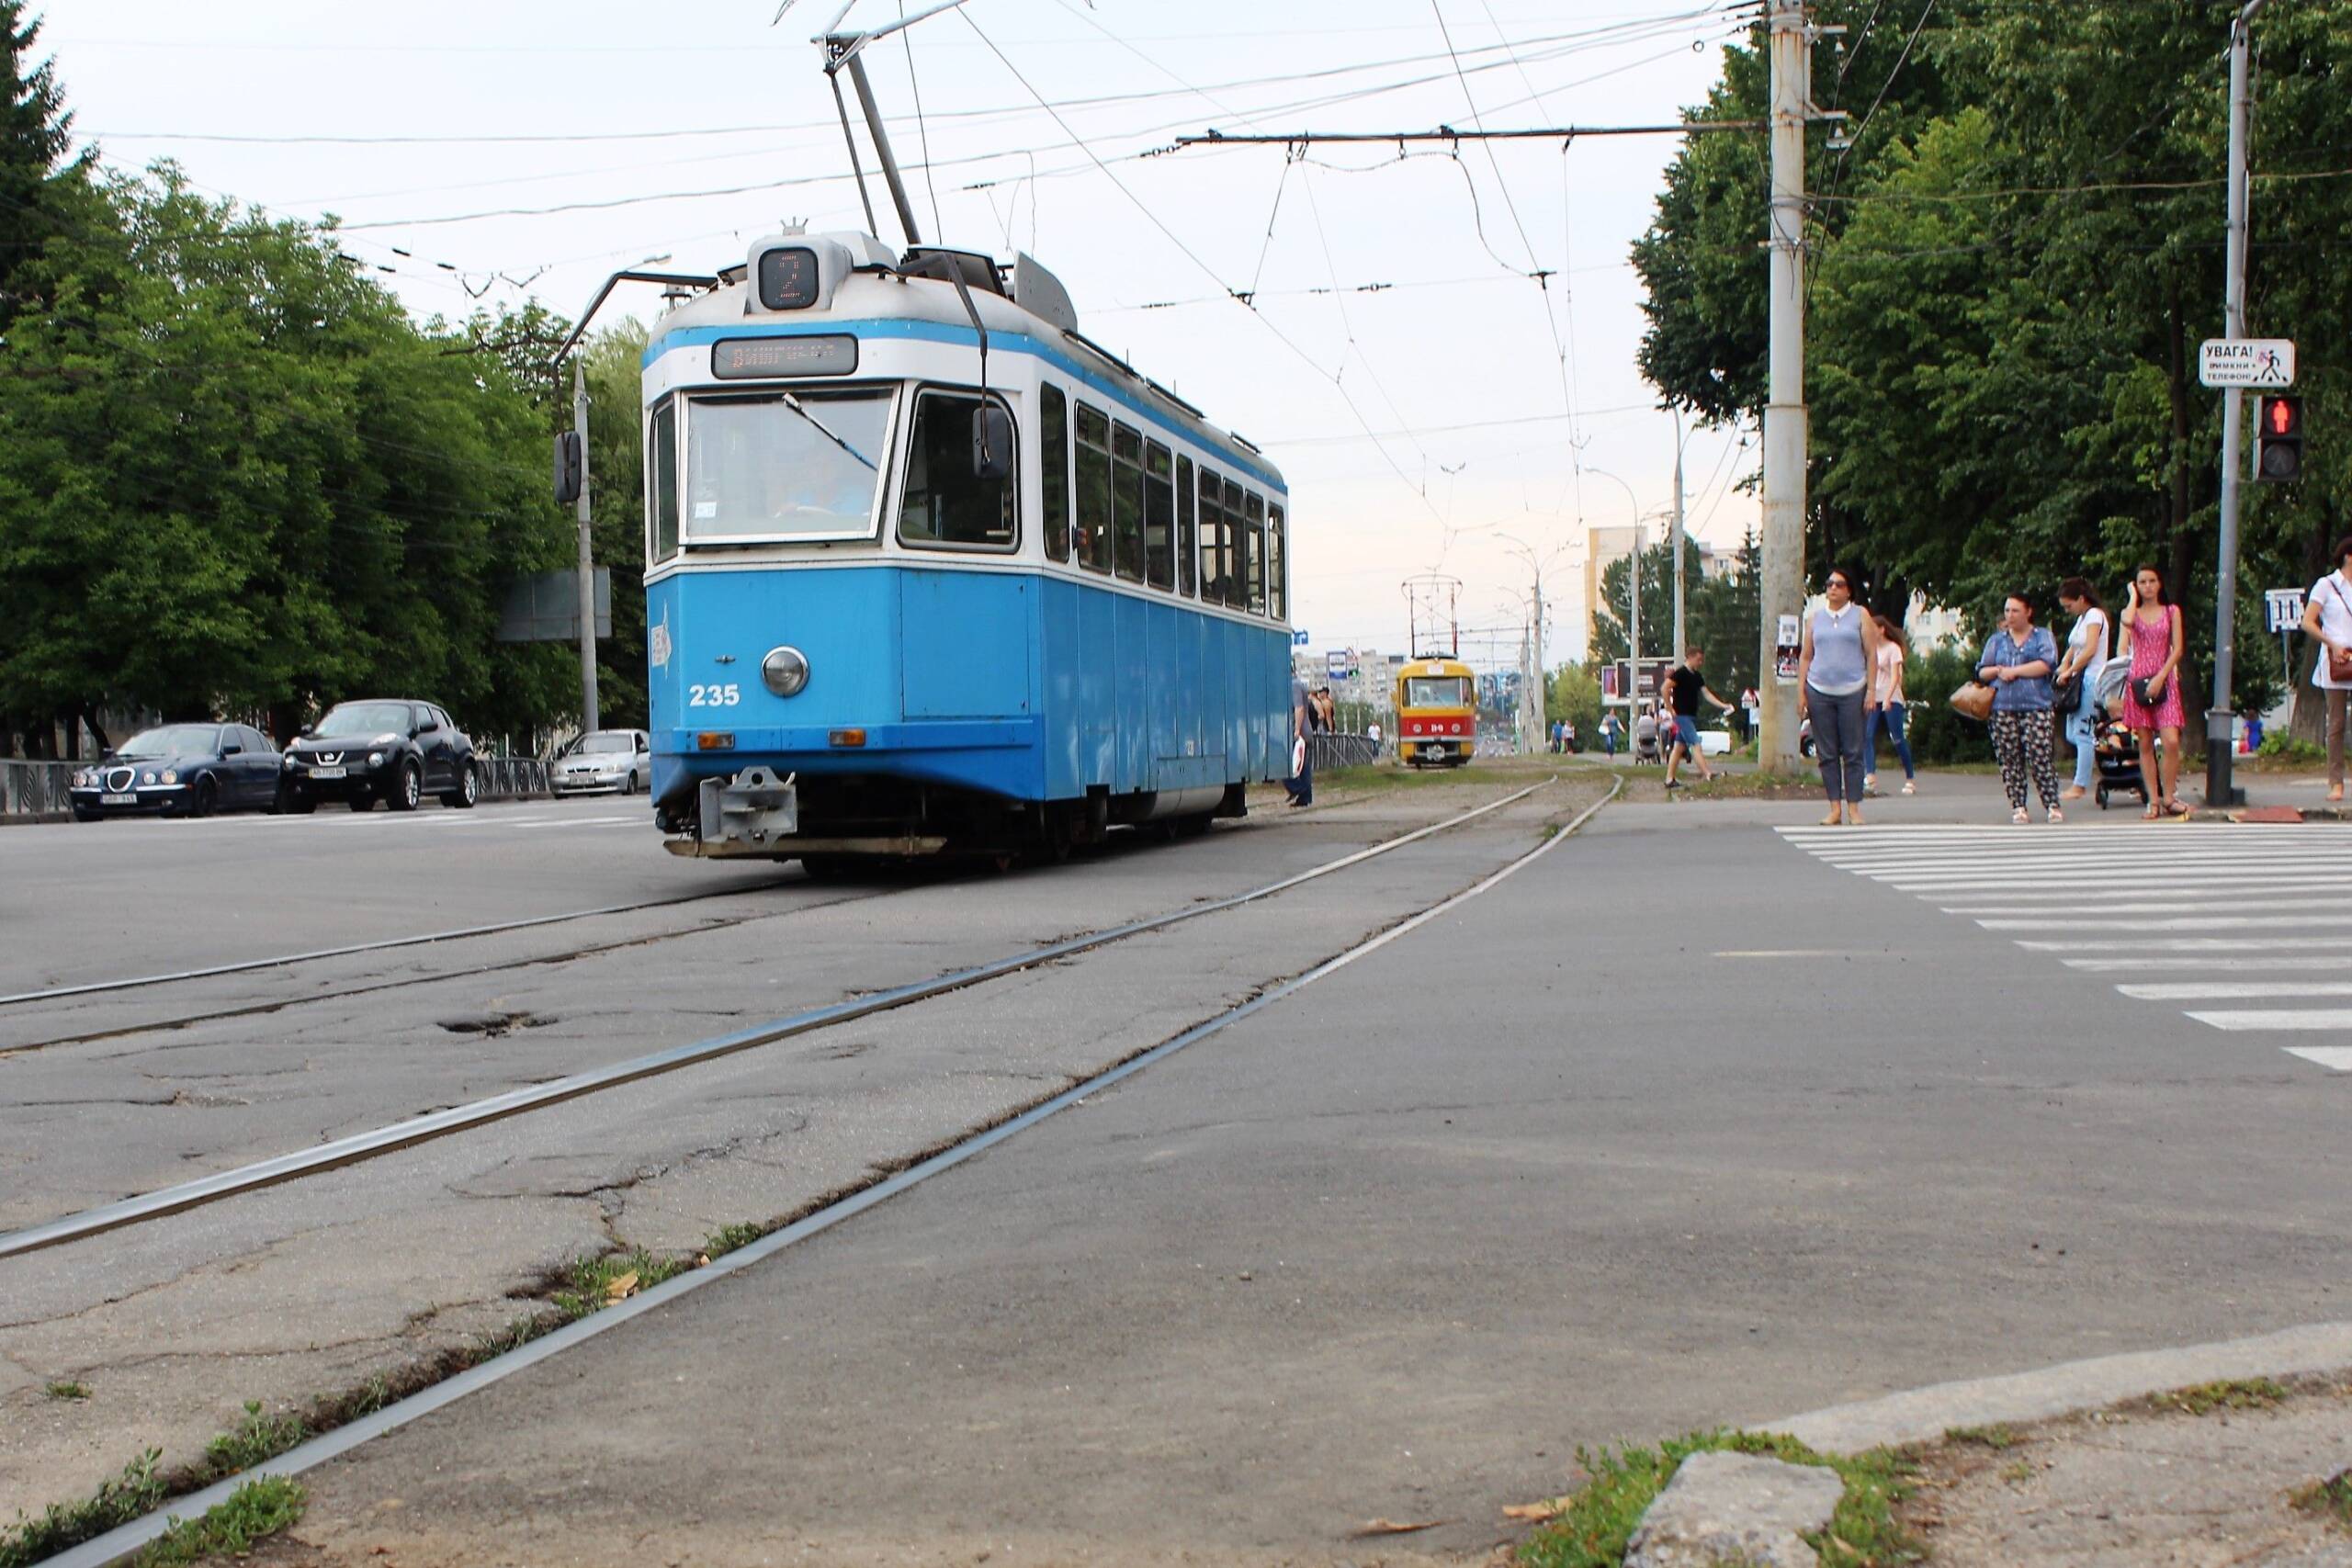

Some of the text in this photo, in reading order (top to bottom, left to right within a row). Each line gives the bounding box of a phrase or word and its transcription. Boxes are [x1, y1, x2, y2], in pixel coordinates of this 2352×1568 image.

[779, 254, 800, 298] 2
[2206, 345, 2253, 357] УВАГА!
[689, 683, 741, 707] 235
